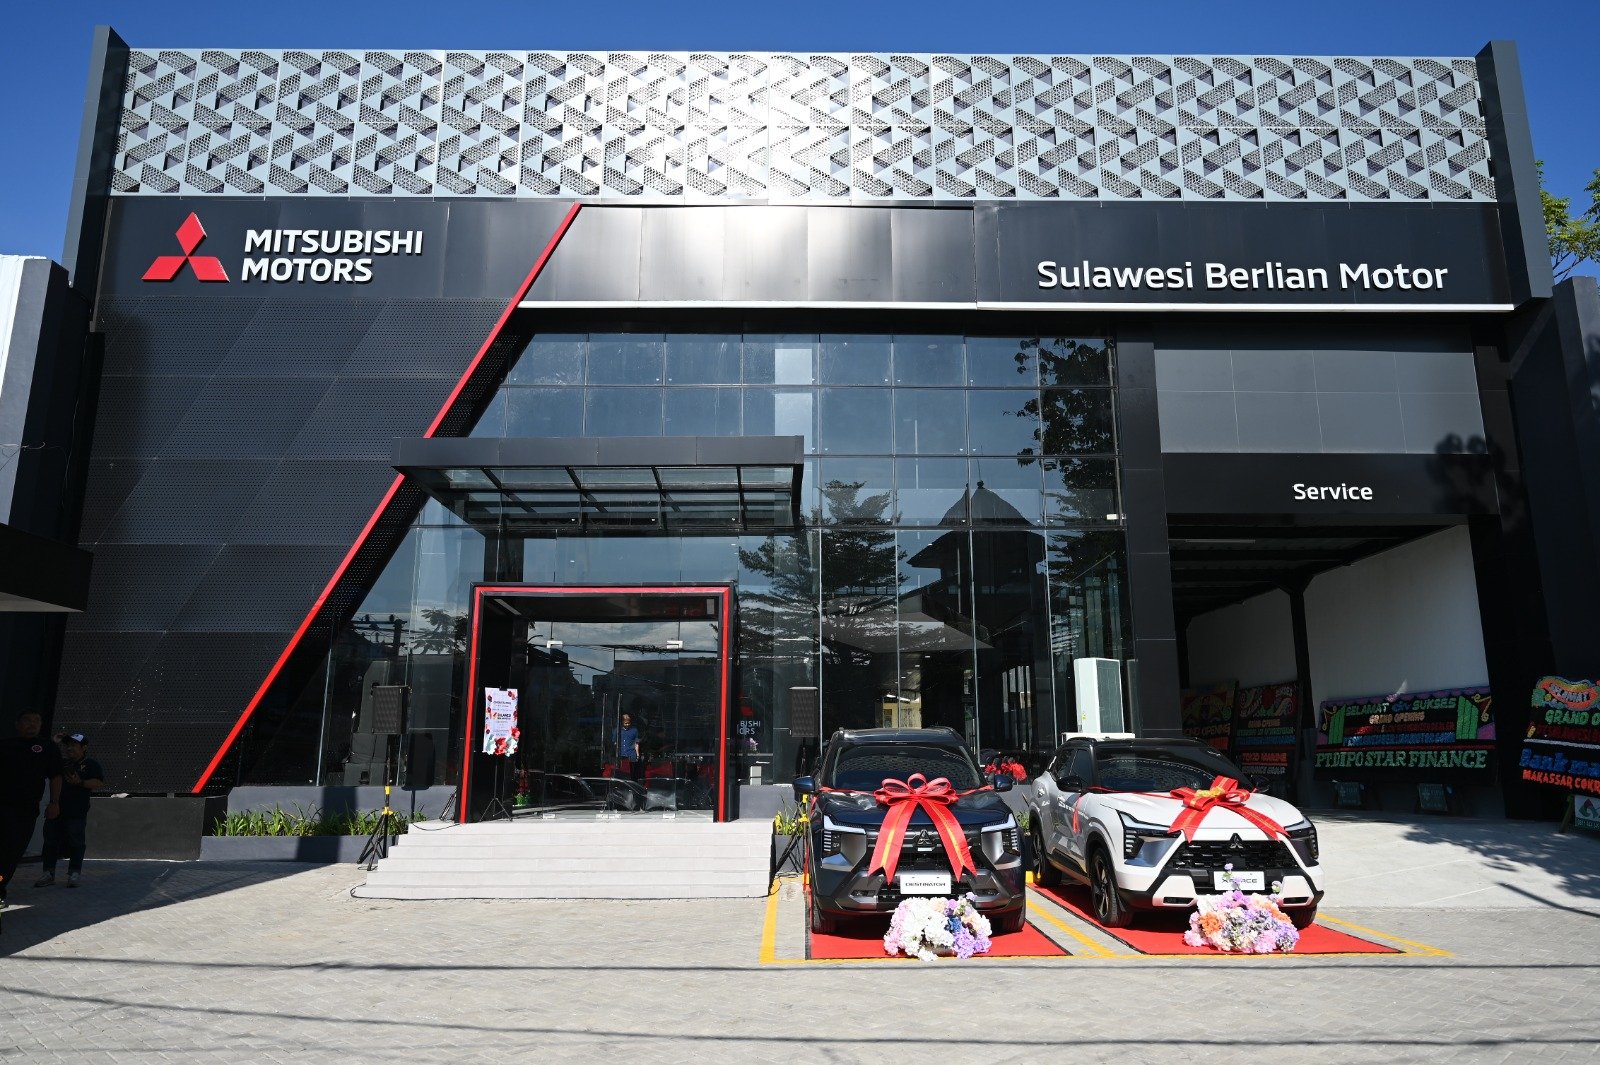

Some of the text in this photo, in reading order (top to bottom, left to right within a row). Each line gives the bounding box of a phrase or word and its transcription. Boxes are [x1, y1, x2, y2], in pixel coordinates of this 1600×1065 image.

[244, 229, 423, 254] MITSUBISHI
[241, 257, 373, 283] MOTORS
[1037, 260, 1449, 291] Sulawesi Berlian Motor
[1293, 482, 1373, 501] Service
[1346, 703, 1390, 717] SELAMAT
[1413, 698, 1457, 711] SUKSES
[1545, 710, 1589, 726] GRAND
[1365, 750, 1407, 768] STAR
[1408, 749, 1488, 769] FINANCE
[1522, 769, 1574, 790] MAKASSAR
